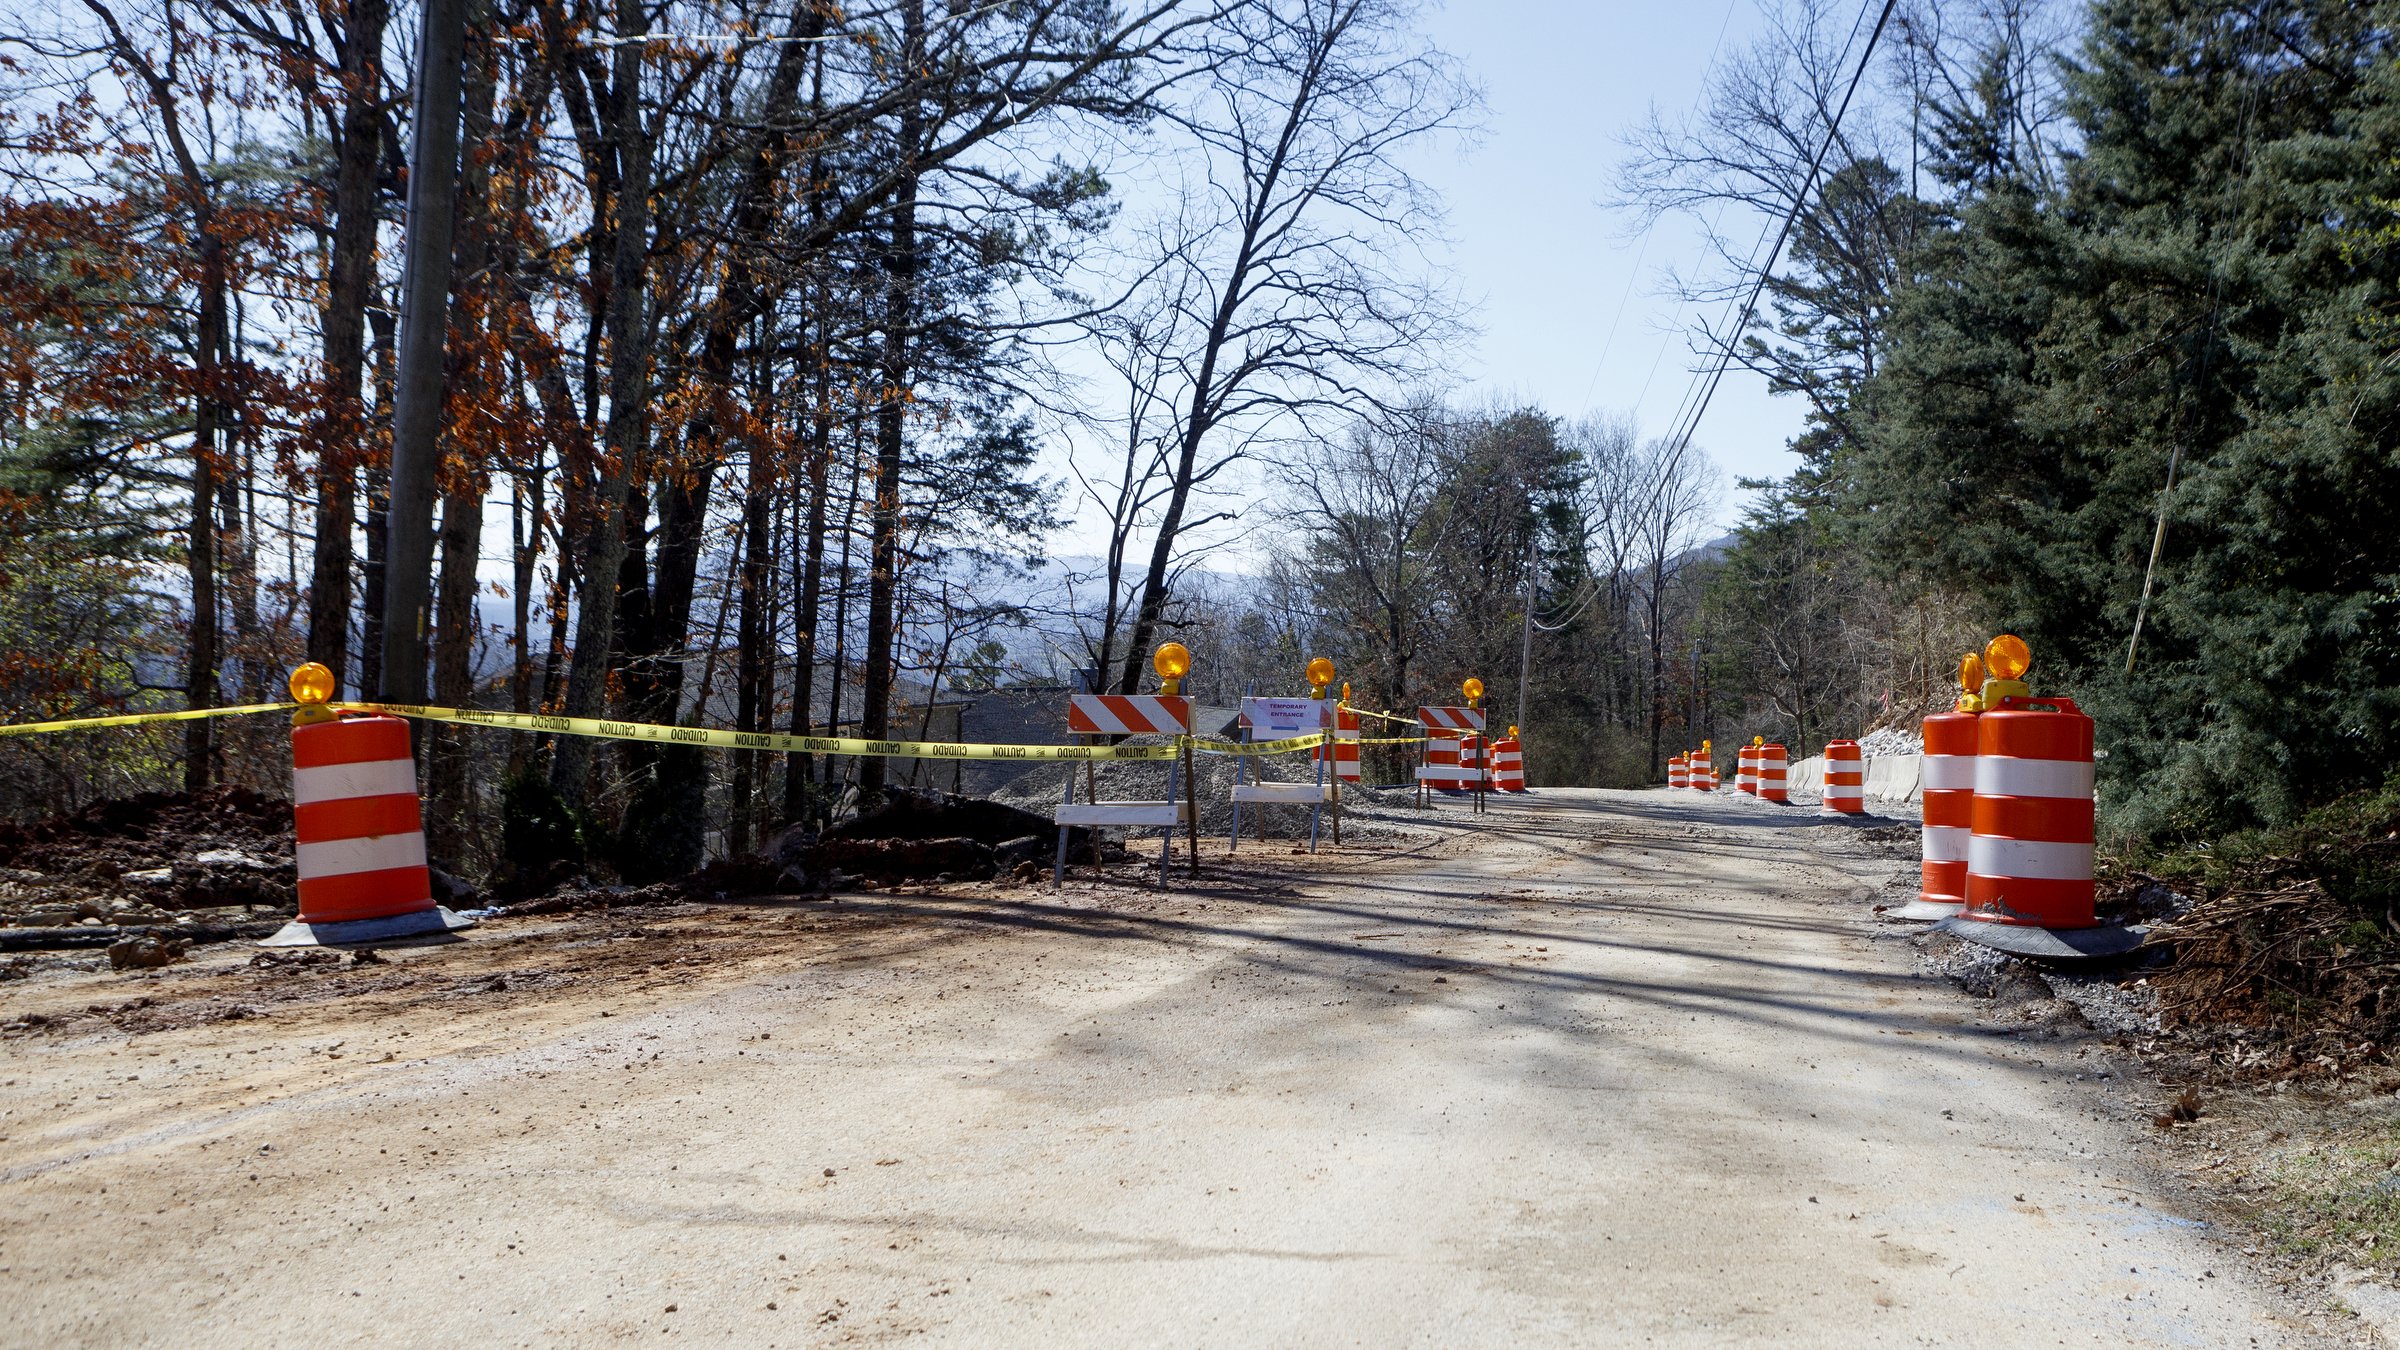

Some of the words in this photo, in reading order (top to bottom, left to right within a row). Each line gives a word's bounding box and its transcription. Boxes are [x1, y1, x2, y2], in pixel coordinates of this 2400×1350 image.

[454, 708, 495, 723] CAUTION
[531, 715, 570, 731] CUIDADO
[599, 722, 636, 737] CAUTION
[670, 728, 708, 743] CUIDADO
[735, 733, 771, 747] CAUTION
[804, 738, 840, 751] CUIDADO
[865, 741, 900, 754] CAUTION
[932, 744, 967, 756] CUIDADO
[992, 746, 1026, 758] CAUTION
[1057, 747, 1091, 758] CUIDADO
[1115, 747, 1149, 758] CAUTION
